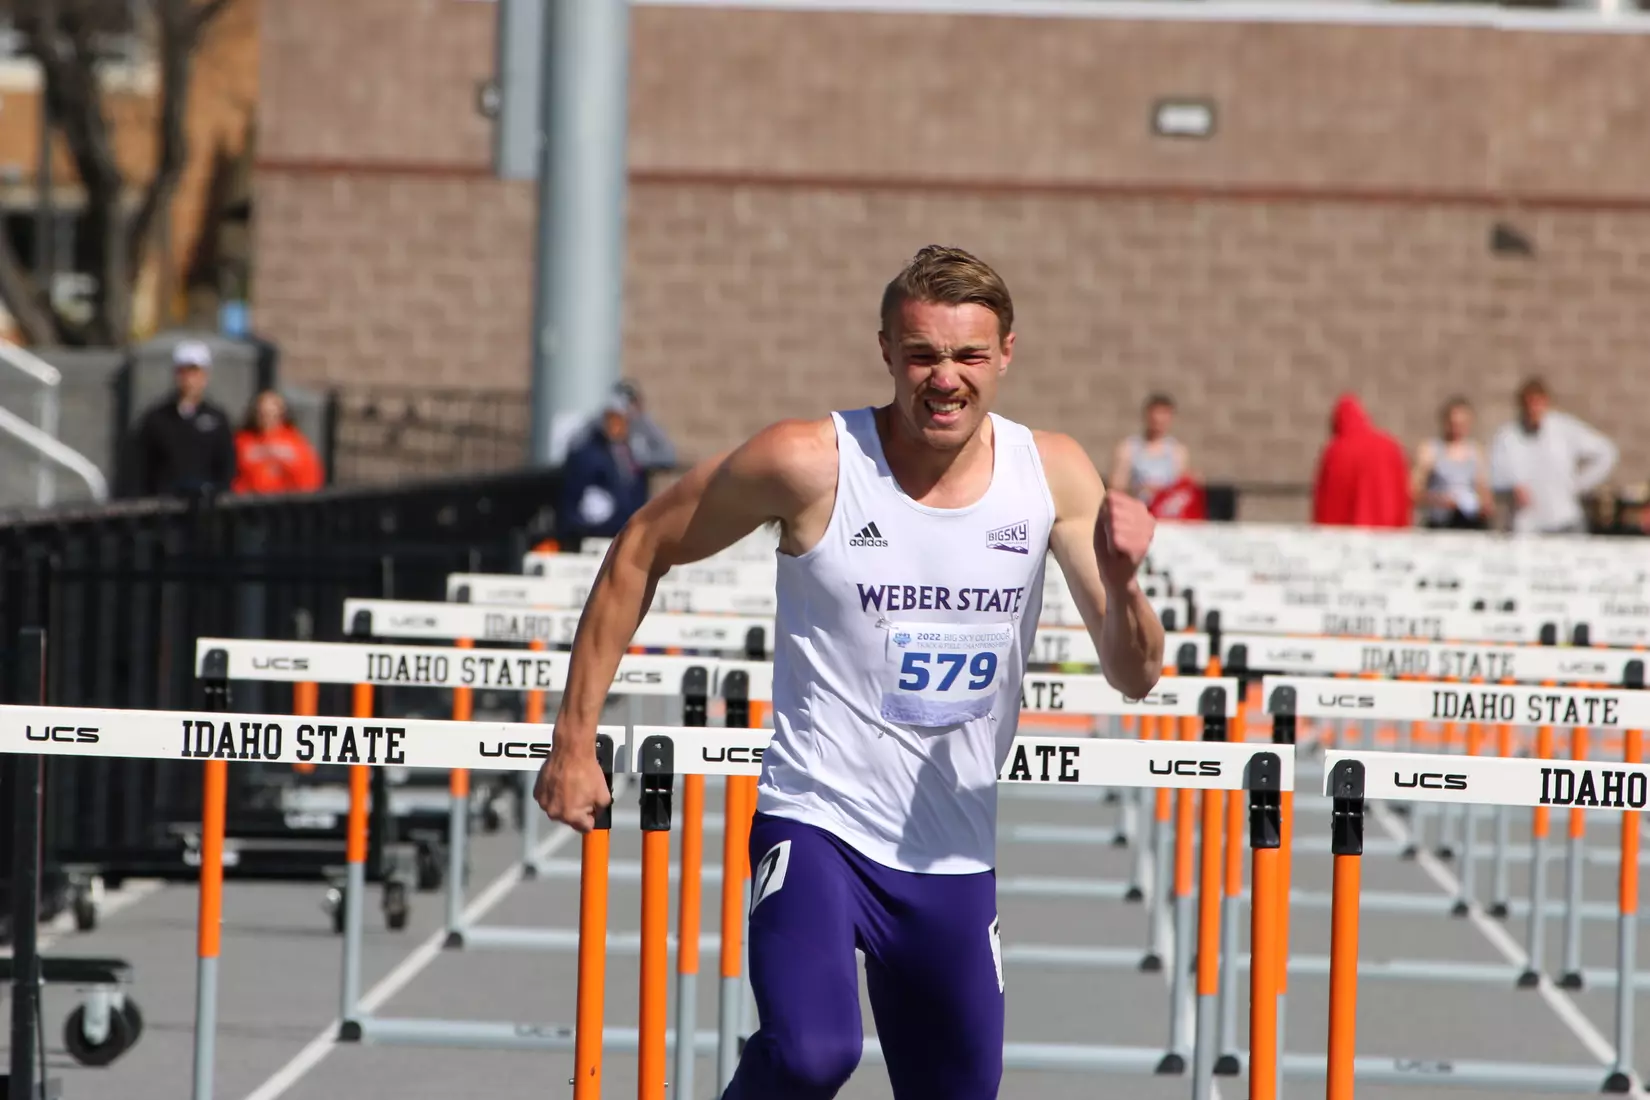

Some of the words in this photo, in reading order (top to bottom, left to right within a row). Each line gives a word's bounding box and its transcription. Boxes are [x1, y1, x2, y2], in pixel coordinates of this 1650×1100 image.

[849, 535, 888, 547] adidas
[856, 583, 952, 613] WEBER
[957, 586, 1025, 613] STATE
[917, 633, 941, 641] 2022
[252, 657, 309, 671] UCS
[367, 653, 449, 683] IDAHO
[461, 657, 550, 688] STATE
[898, 652, 998, 692] 579
[1318, 694, 1375, 708] UCS
[1432, 691, 1515, 720] IDAHO
[1527, 695, 1619, 725] STATE
[26, 725, 99, 743] UCS
[182, 720, 282, 760] IDAHO
[296, 724, 405, 764] STATE
[479, 741, 552, 759] UCS
[1149, 759, 1221, 776] UCS
[1394, 771, 1468, 790] UCS
[1539, 767, 1648, 809] IDAHO
